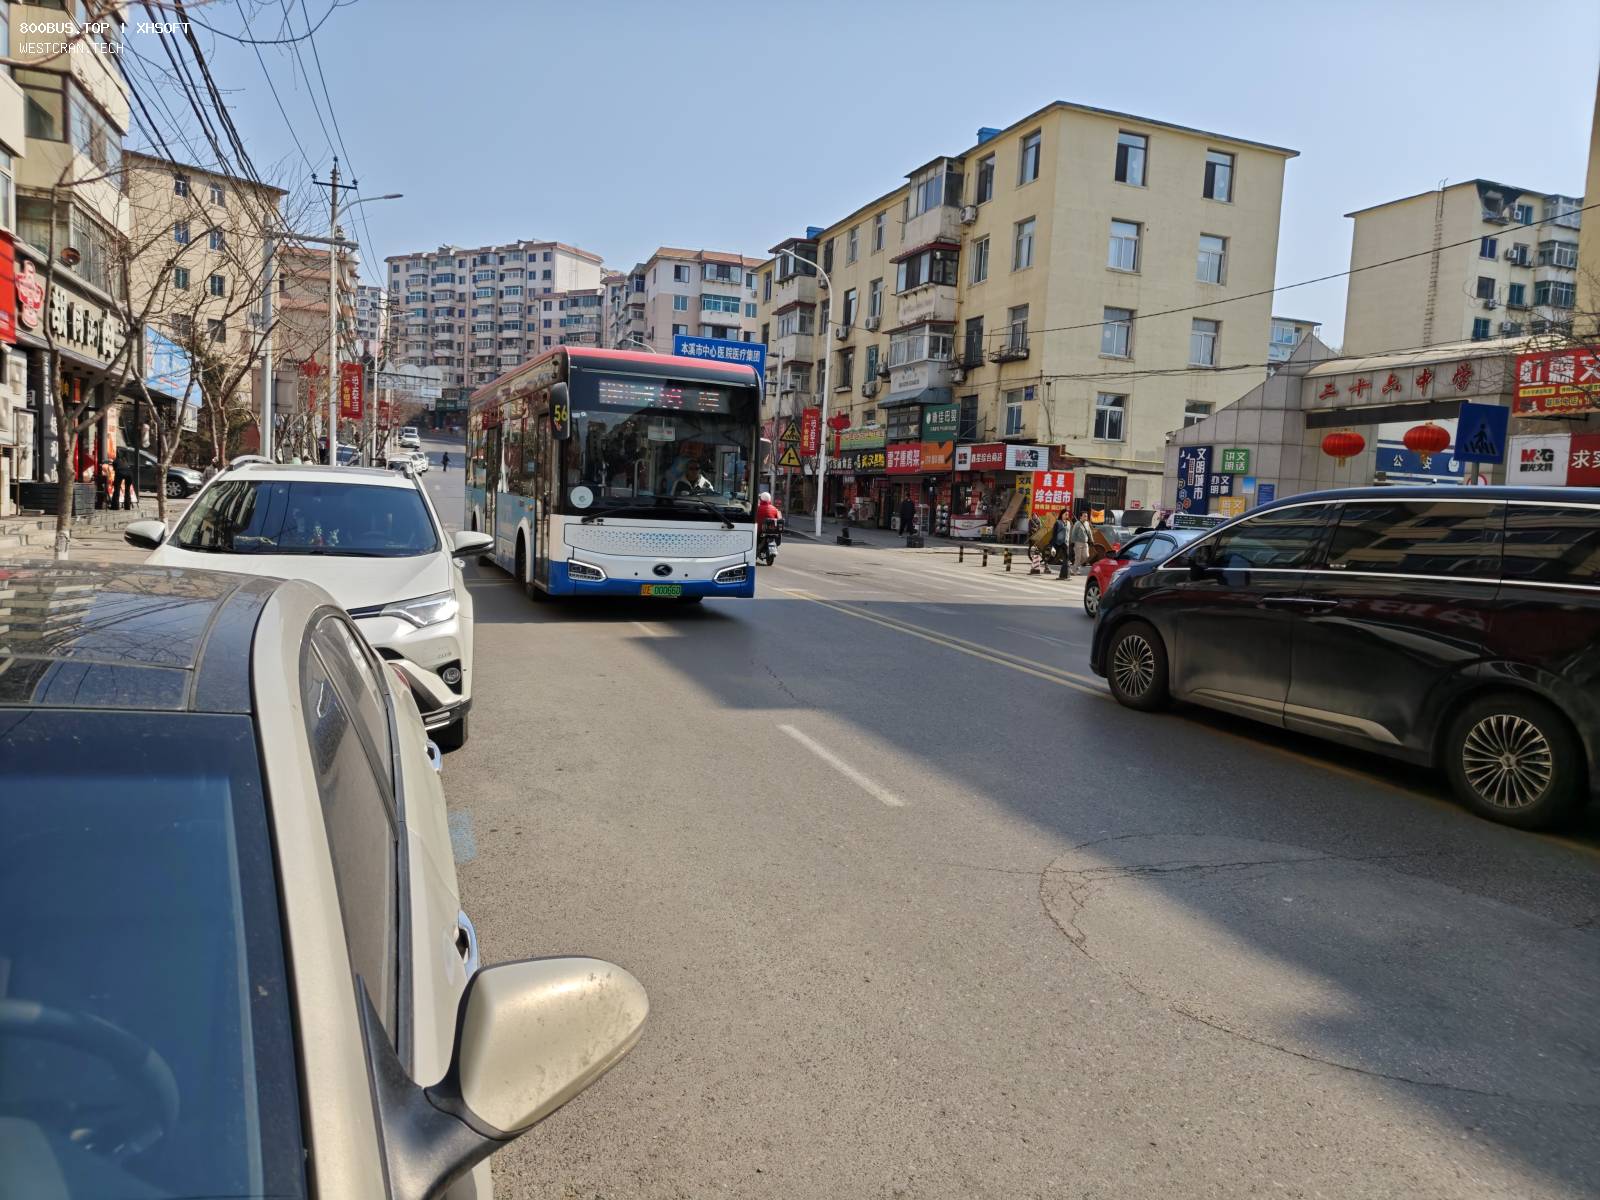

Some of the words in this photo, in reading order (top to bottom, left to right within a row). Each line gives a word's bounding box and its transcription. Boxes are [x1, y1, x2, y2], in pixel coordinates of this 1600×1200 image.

[681, 341, 761, 363] 本溪市中心医院医疗集团
[553, 404, 568, 422] 56
[1521, 448, 1554, 463] M&G
[1035, 488, 1072, 504] 综合超市
